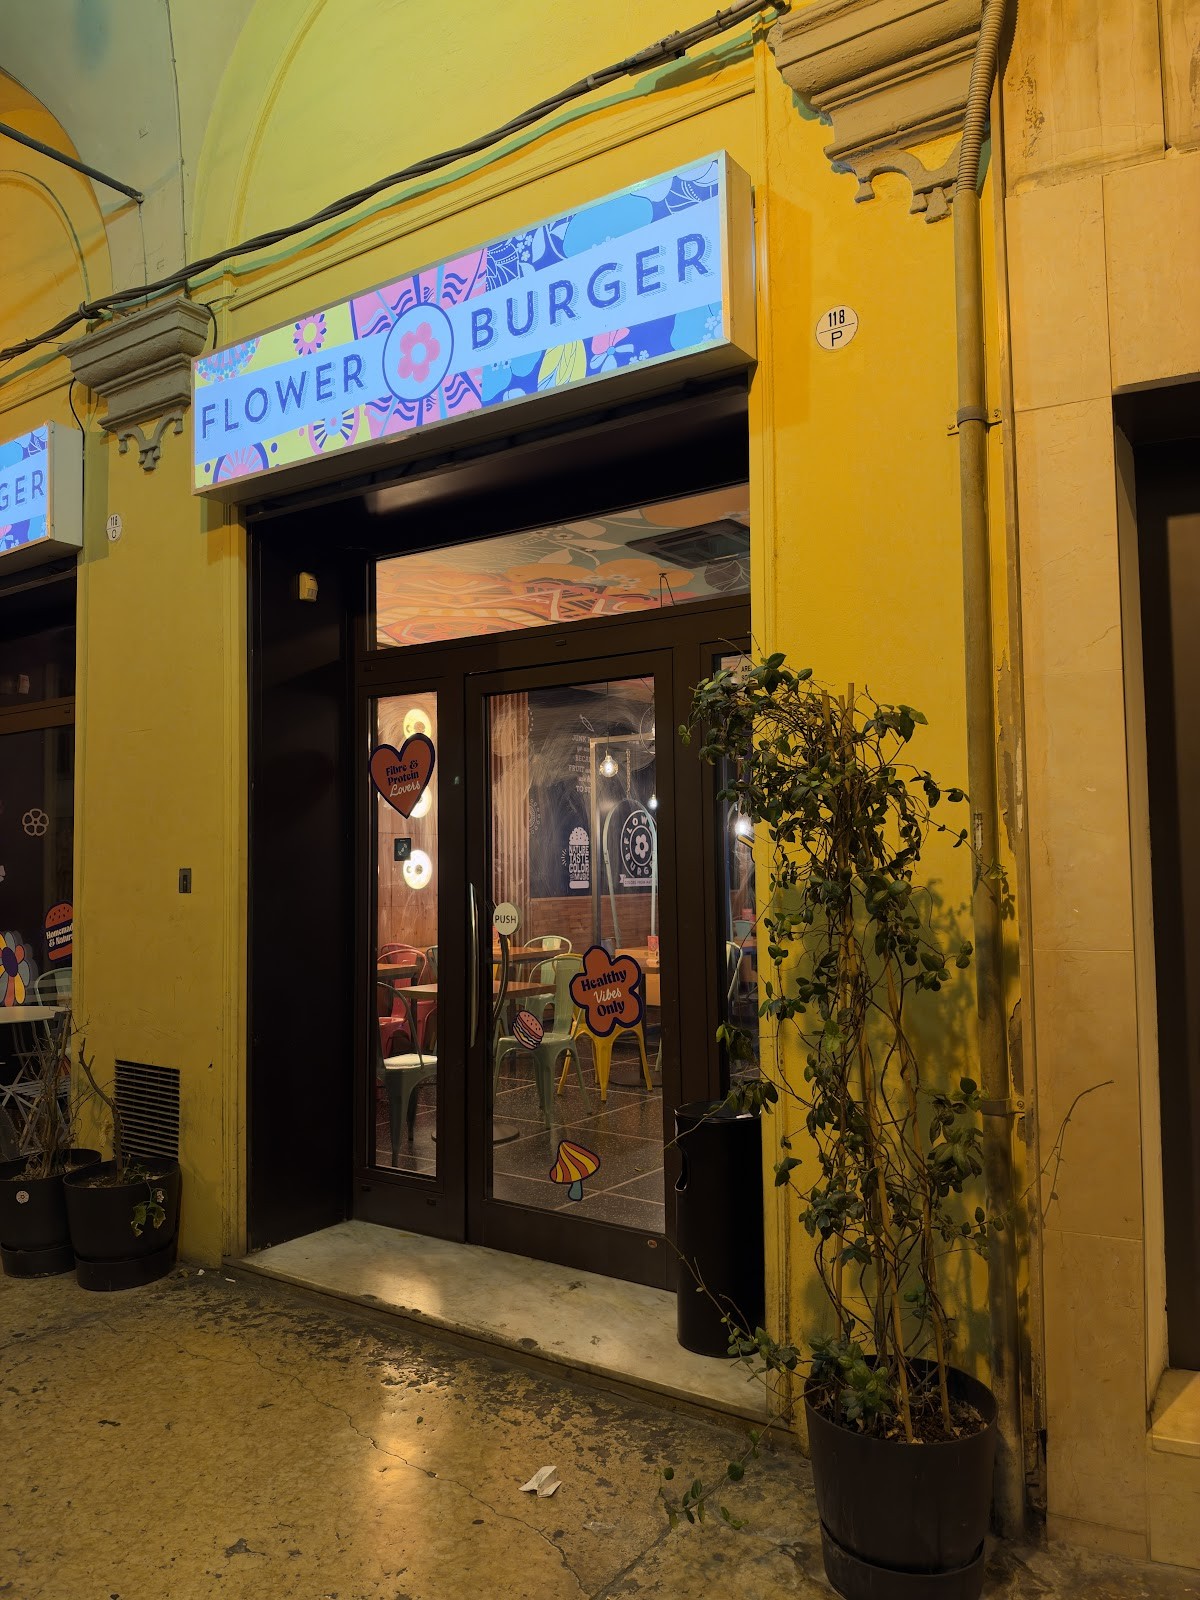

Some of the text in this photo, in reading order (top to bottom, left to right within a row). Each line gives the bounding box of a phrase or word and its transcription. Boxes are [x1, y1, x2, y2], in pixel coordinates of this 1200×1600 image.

[829, 309, 845, 327] 118
[201, 232, 713, 439] FLOWER BURGER
[831, 330, 843, 347] P
[386, 760, 418, 776] Fibre &
[387, 770, 419, 785] Protein
[390, 781, 420, 797] Lovers
[568, 845, 590, 853] NATURE
[568, 853, 590, 863] TASTE
[568, 863, 590, 873] COLOR
[494, 914, 517, 924] PUSH
[580, 969, 627, 992] Healthy
[593, 987, 622, 1004] Vibes
[597, 1000, 625, 1017] Only
